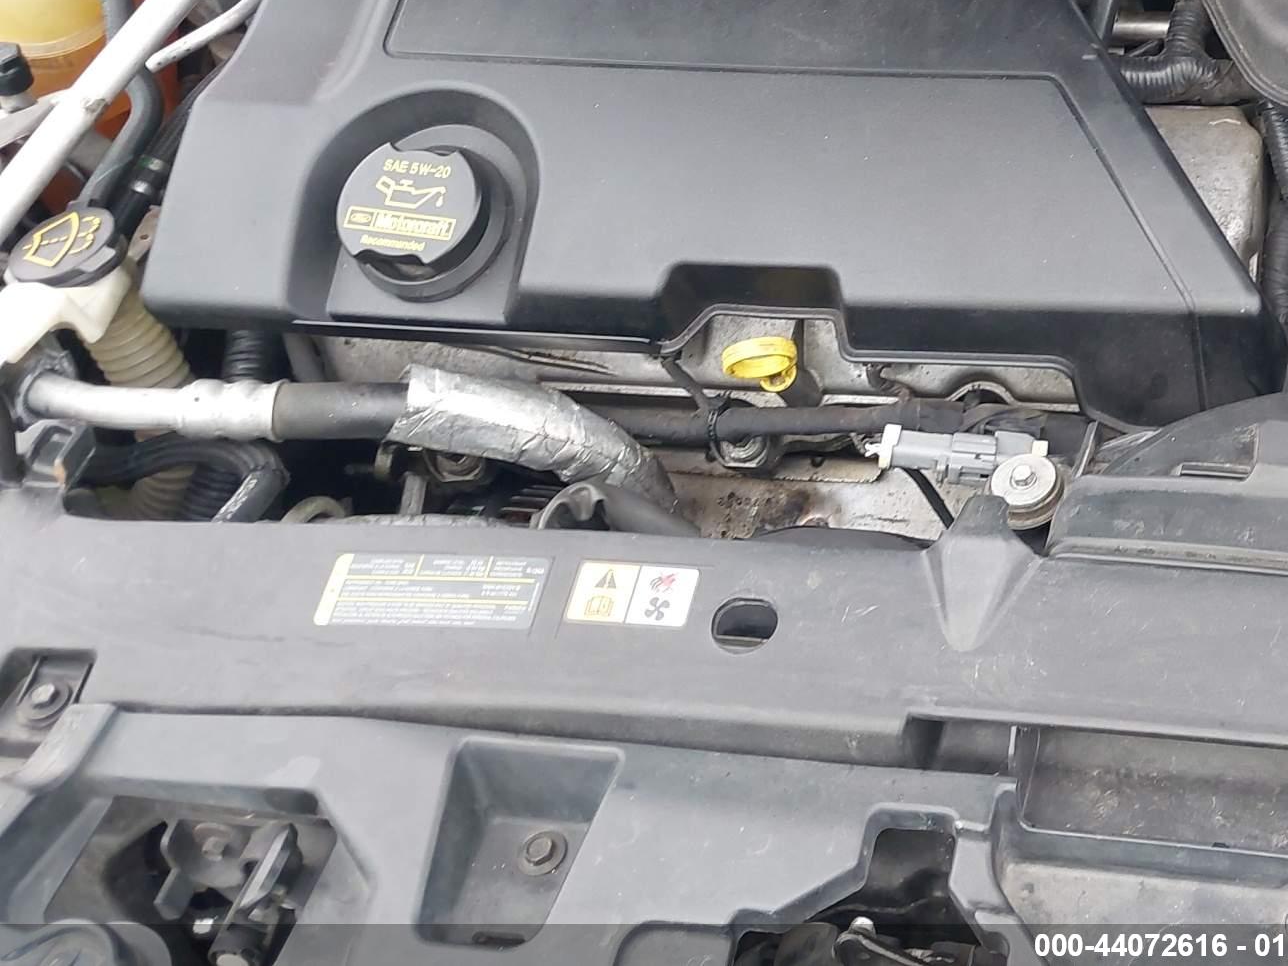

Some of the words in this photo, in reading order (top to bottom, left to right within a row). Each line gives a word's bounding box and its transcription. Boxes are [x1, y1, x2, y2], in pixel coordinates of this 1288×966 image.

[383, 158, 408, 174] SAE
[409, 162, 451, 179] 5W-20
[375, 213, 451, 238] Motorcraft
